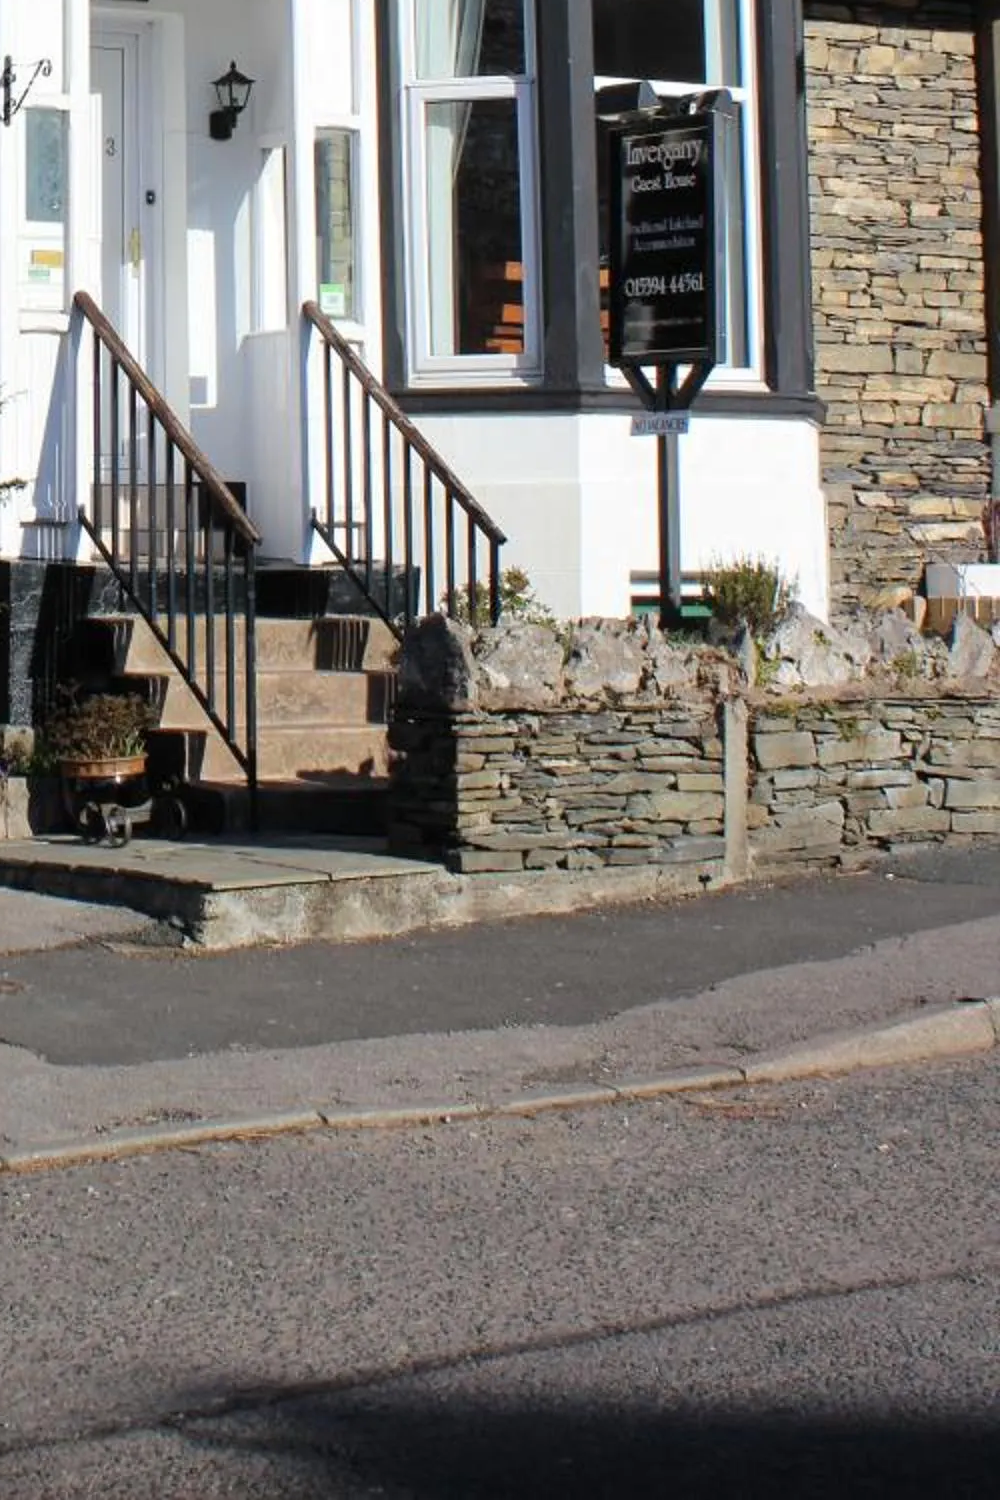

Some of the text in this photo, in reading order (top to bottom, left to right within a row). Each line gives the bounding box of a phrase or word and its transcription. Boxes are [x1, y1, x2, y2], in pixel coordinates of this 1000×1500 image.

[105, 137, 115, 157] 3
[626, 140, 702, 170] Invergarry
[632, 172, 696, 193] Guest House
